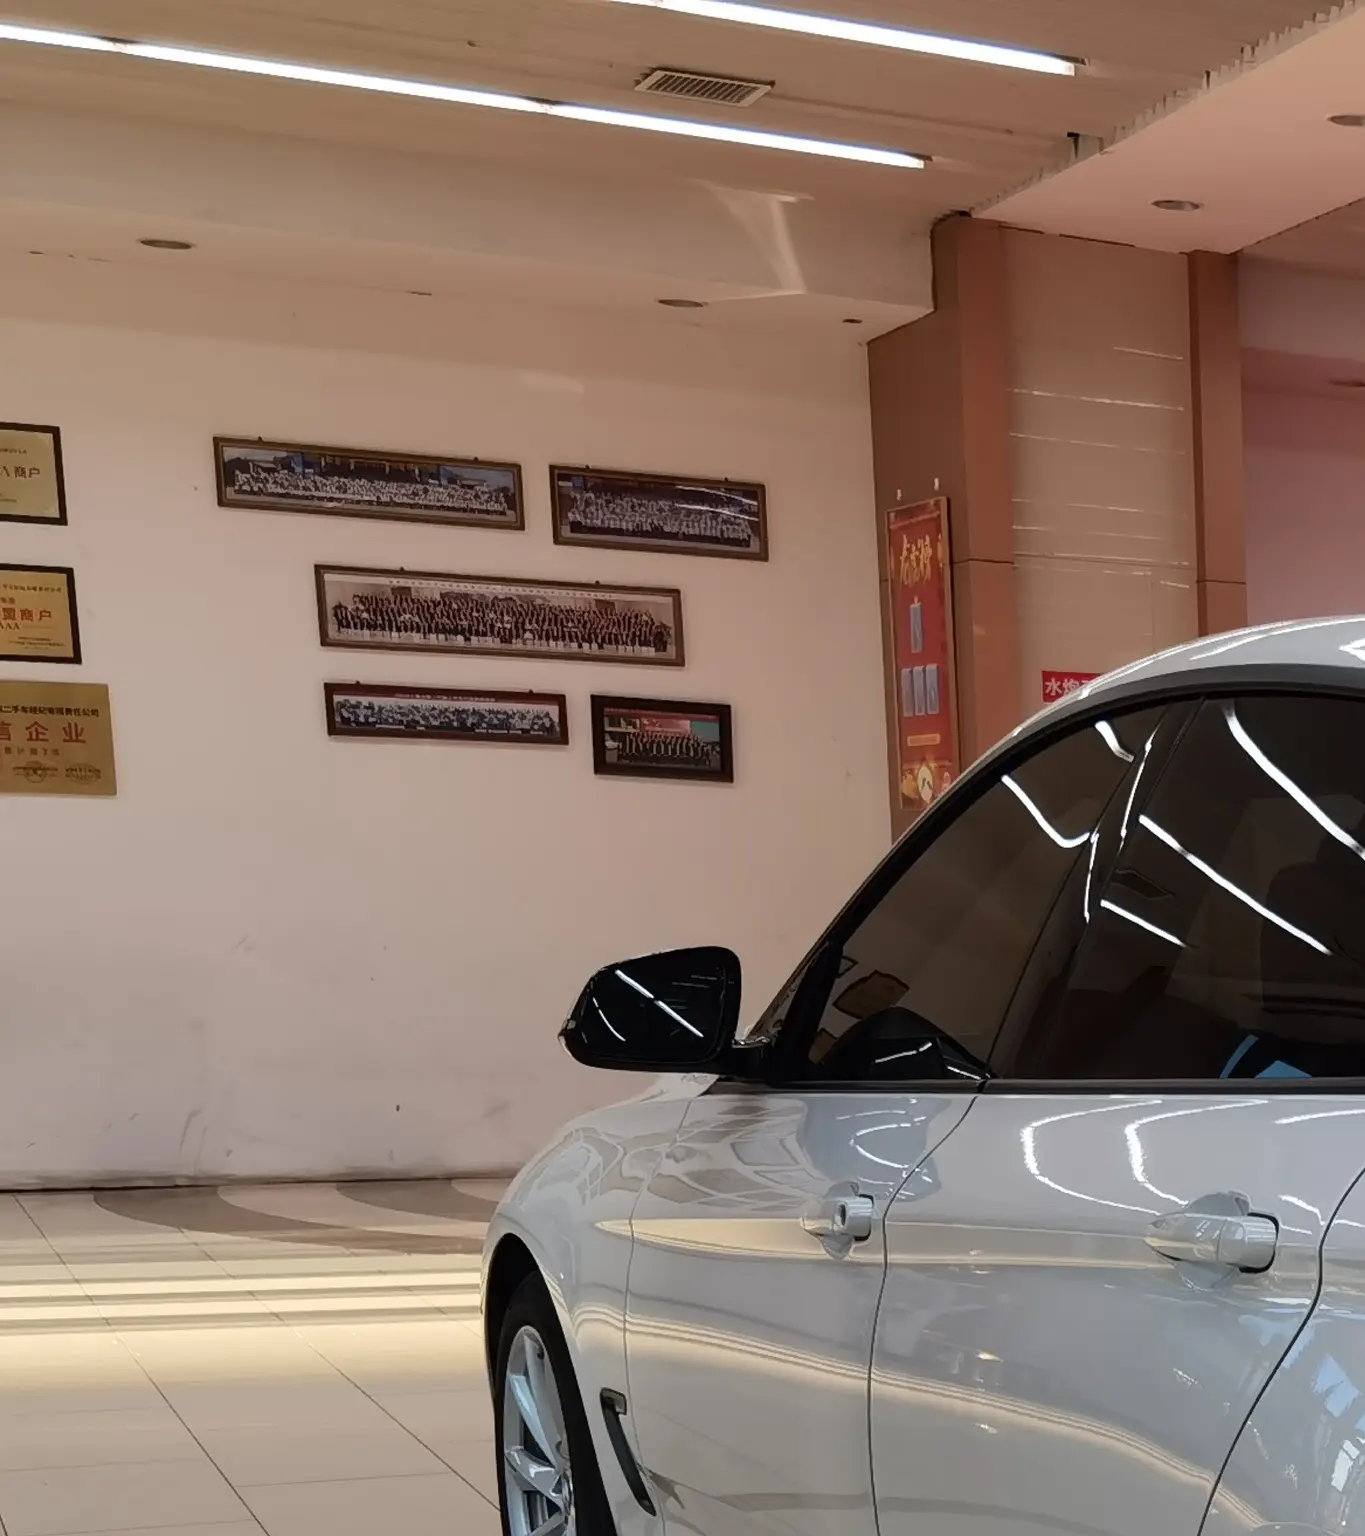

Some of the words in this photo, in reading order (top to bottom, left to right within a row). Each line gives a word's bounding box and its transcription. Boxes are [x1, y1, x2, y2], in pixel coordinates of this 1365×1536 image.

[1044, 677, 1089, 697] 水炮
[0, 704, 99, 718] 二手车经纪有限责任公司
